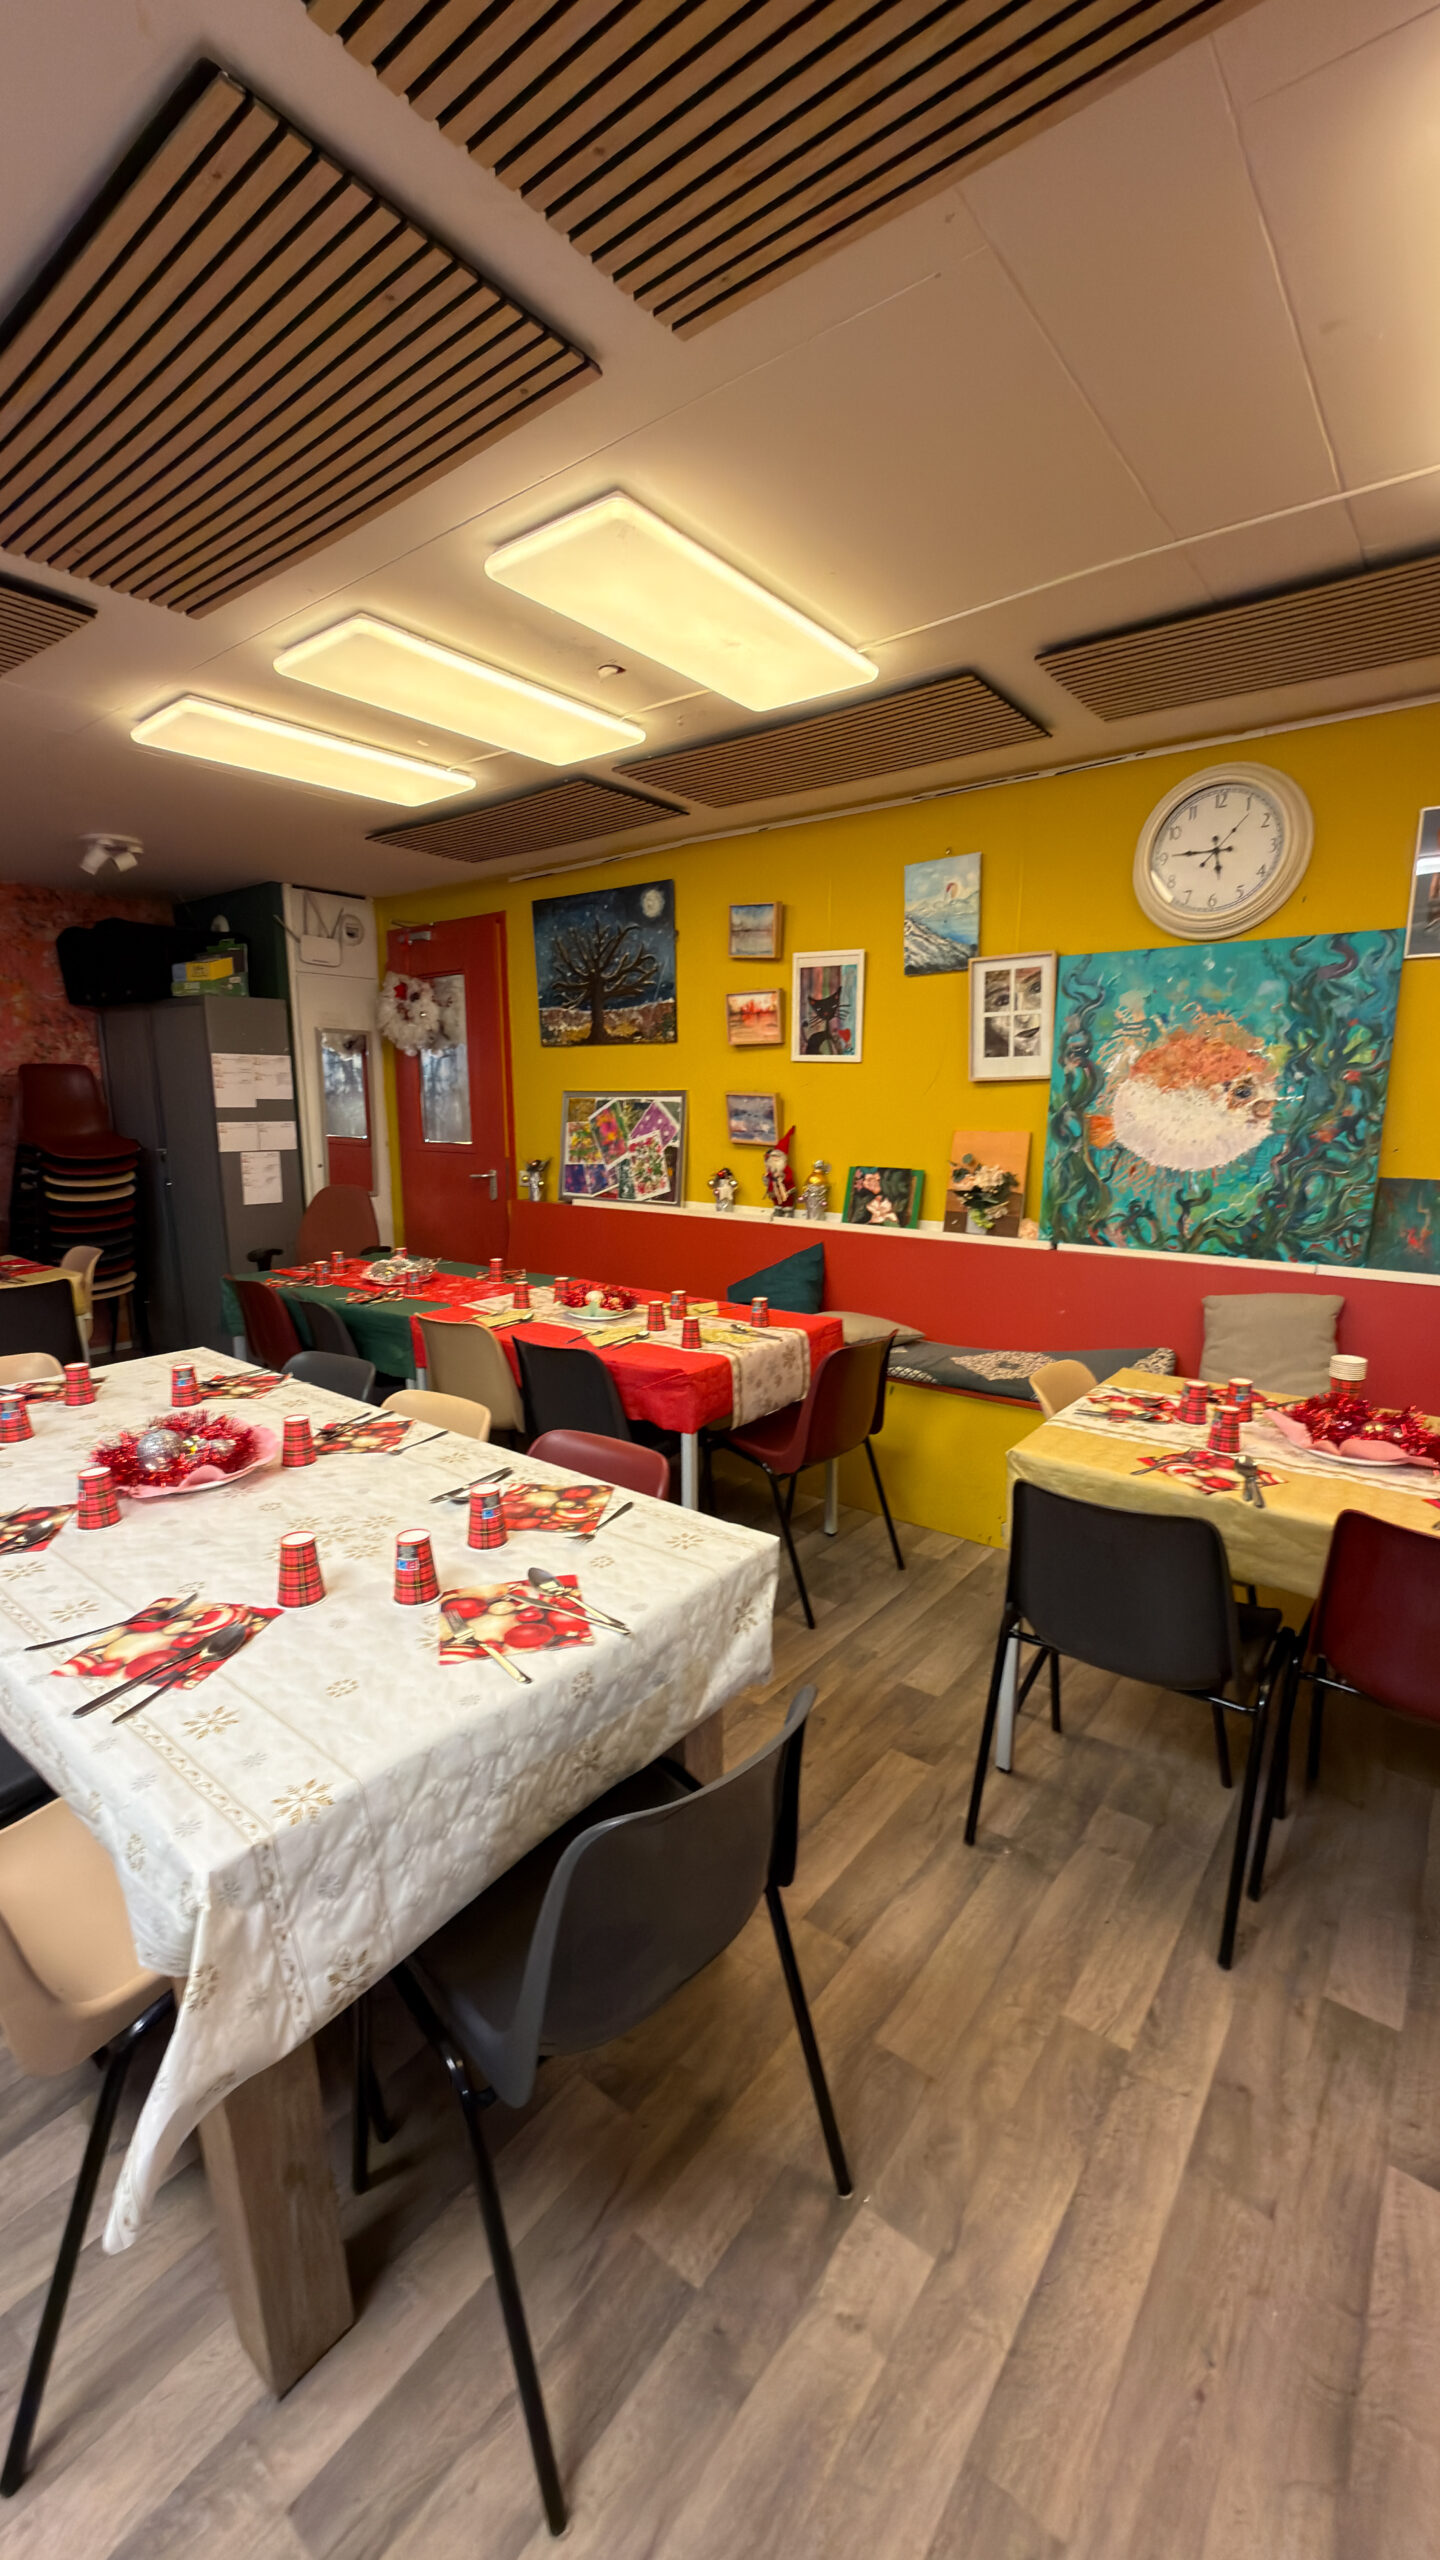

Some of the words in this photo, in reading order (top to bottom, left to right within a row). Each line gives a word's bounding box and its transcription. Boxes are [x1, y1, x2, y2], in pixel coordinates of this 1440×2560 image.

[1215, 792, 1228, 808] 12
[1247, 792, 1254, 811] 1
[1189, 806, 1197, 820] 11
[1261, 813, 1269, 828] 2
[1169, 826, 1181, 840] 10
[1270, 838, 1277, 852] 3
[1160, 853, 1168, 865] 9
[1256, 864, 1265, 877] 4
[1167, 875, 1176, 888] 8
[1184, 890, 1192, 904] 7
[1236, 885, 1244, 898] 5
[1208, 893, 1216, 907] 6
